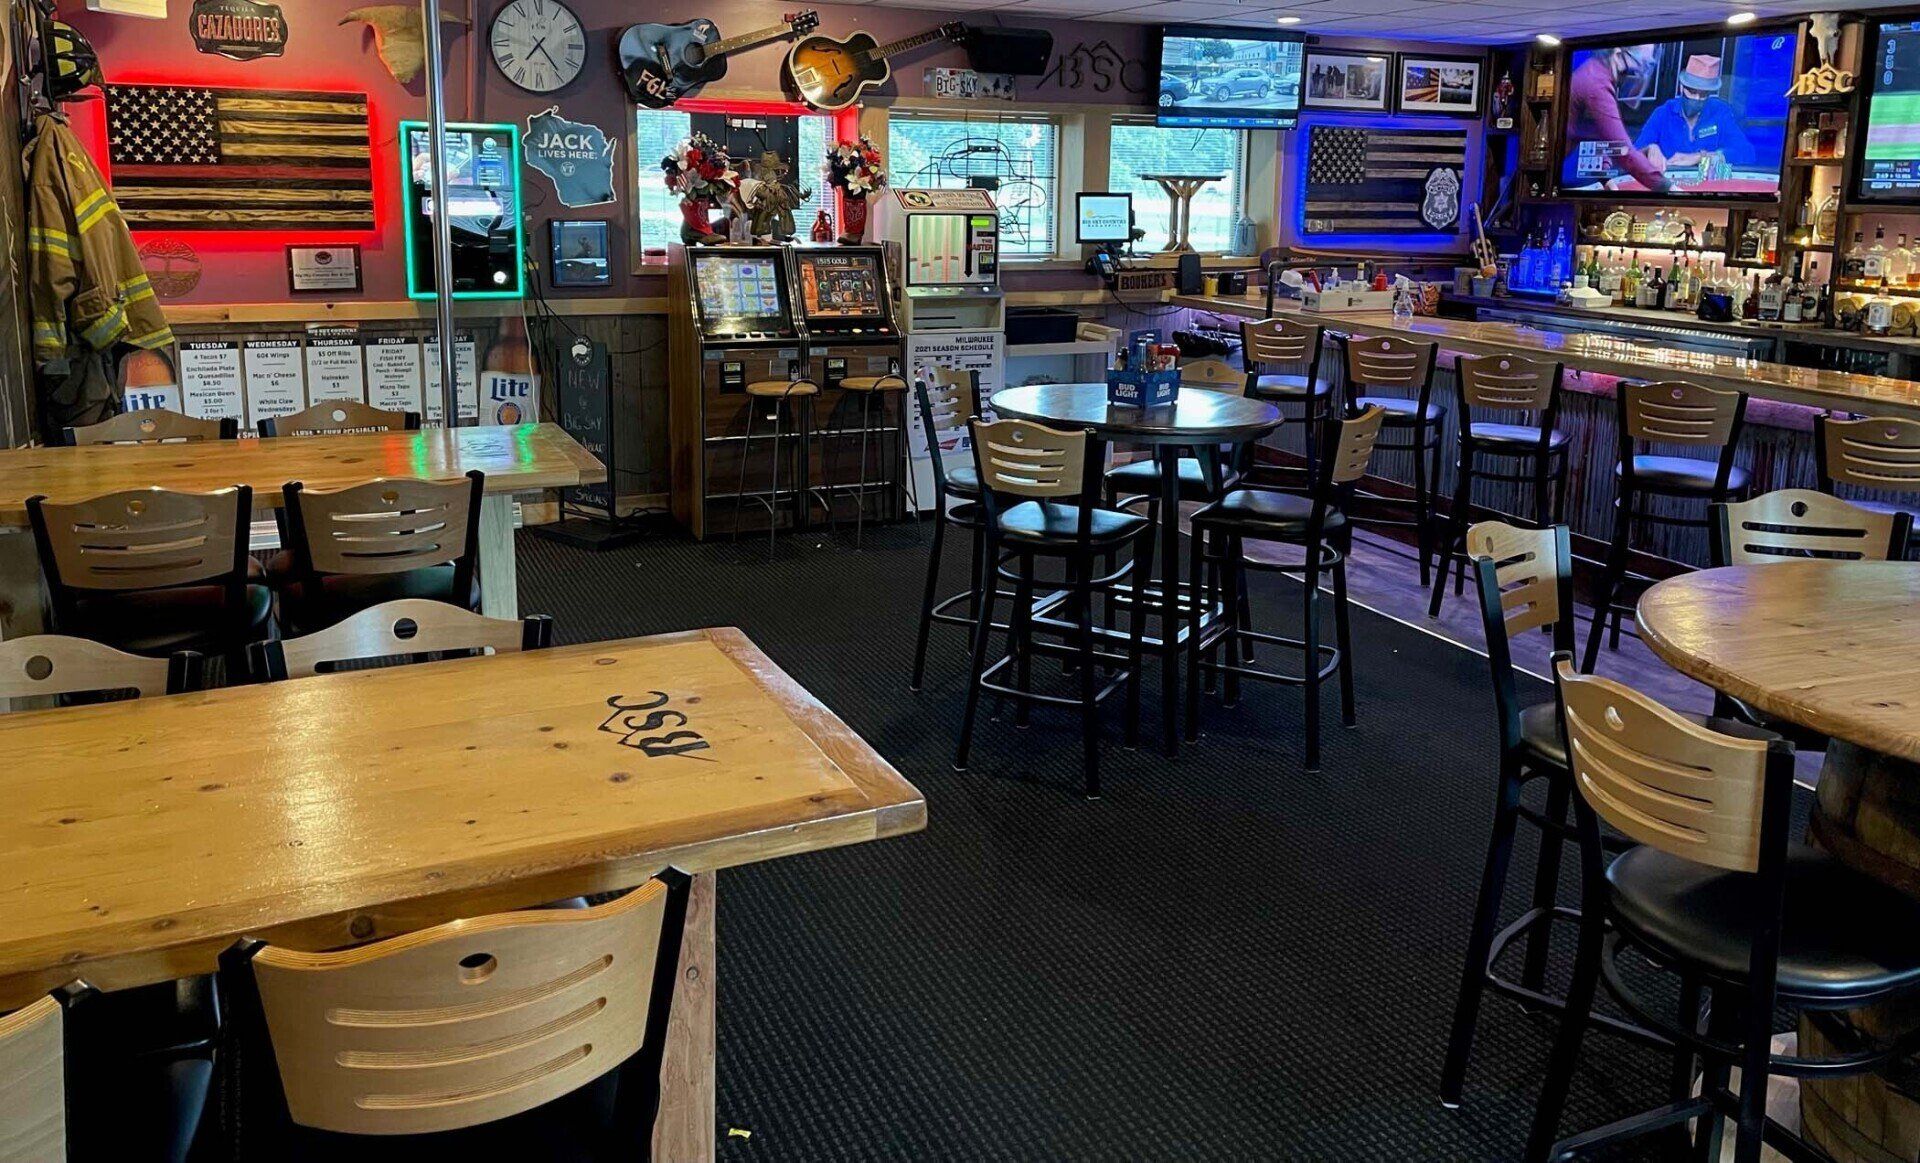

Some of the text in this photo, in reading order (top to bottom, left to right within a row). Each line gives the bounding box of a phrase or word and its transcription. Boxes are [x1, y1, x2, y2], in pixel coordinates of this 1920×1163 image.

[219, 5, 256, 13] TEQUILA
[197, 14, 281, 43] CAZADORES
[1796, 69, 1856, 96] BSC
[538, 133, 594, 150] JACK
[538, 150, 598, 160] LIVES HERE.
[831, 257, 848, 265] GOLD
[247, 340, 298, 348] WEDNESDAY
[955, 336, 994, 344] MILWAUKEE
[190, 342, 228, 350] TUESDAY
[914, 345, 931, 353] 2021
[568, 369, 601, 390] NEW
[491, 377, 530, 402] Lite
[1118, 383, 1136, 391] BUD
[1159, 383, 1170, 391] BUD
[1115, 389, 1139, 398] LIGHT
[1156, 389, 1171, 398] LIGHT
